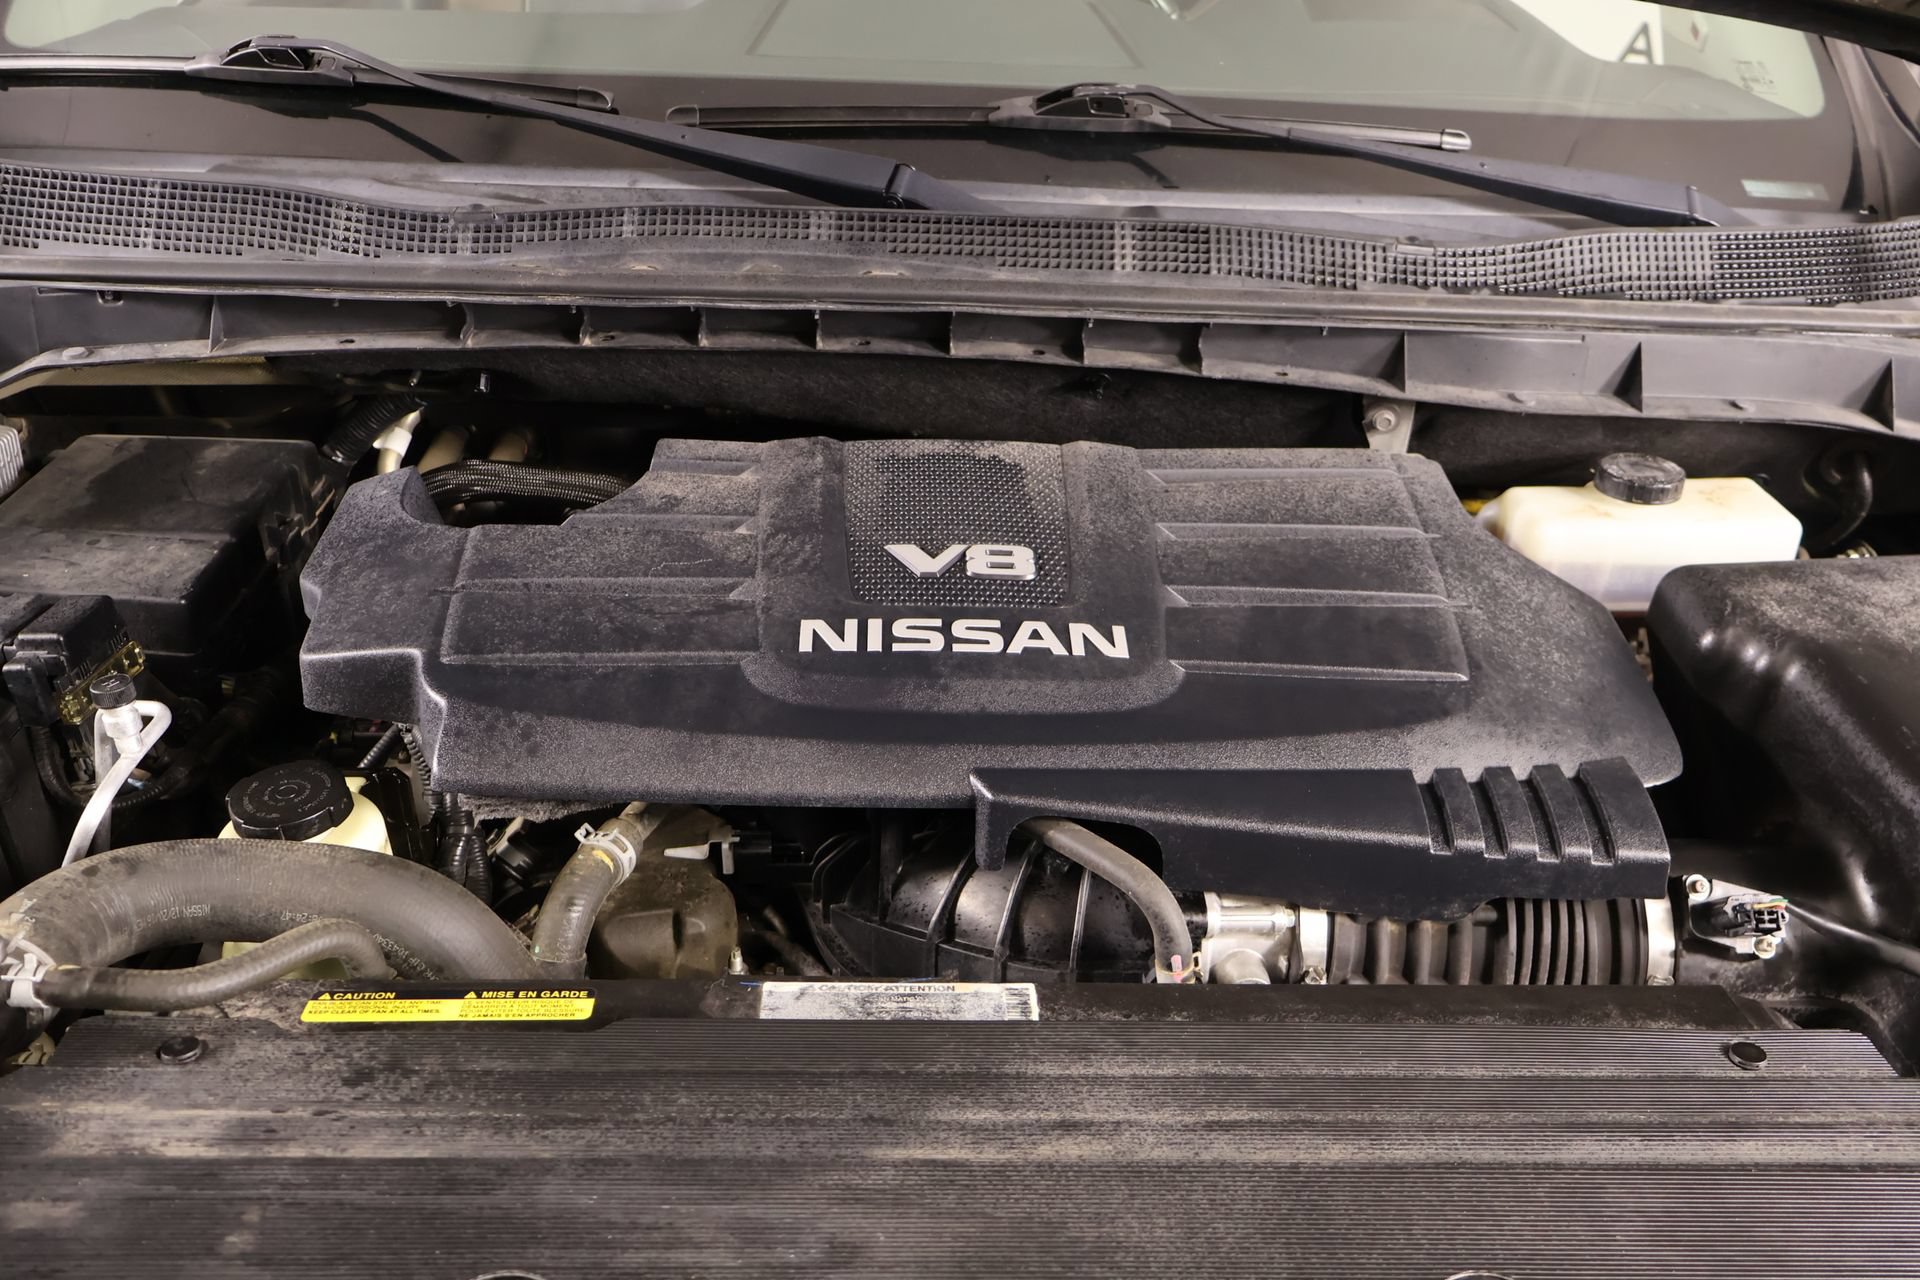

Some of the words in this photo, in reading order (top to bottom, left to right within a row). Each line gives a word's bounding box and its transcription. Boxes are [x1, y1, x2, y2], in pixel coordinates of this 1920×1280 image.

[884, 544, 1038, 580] V8
[799, 618, 1130, 658] NISSAN
[333, 992, 396, 1000] CAUTION
